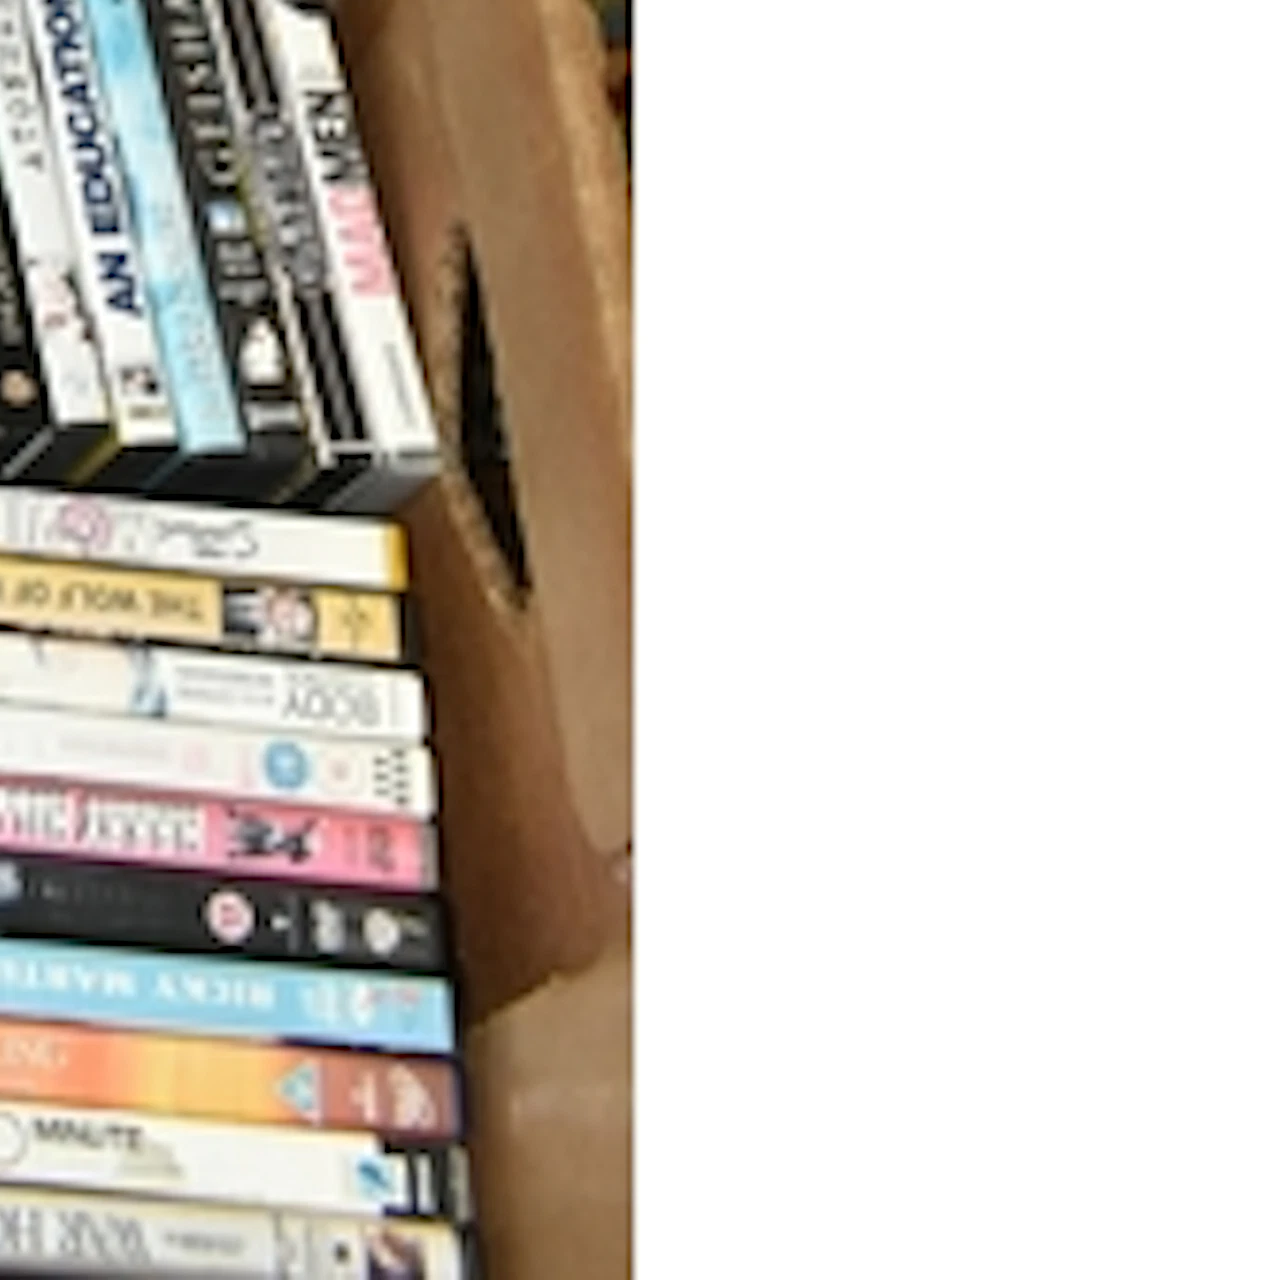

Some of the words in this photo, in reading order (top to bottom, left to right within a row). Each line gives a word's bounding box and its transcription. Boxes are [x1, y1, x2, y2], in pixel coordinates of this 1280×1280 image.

[304, 91, 366, 184] MEN
[331, 186, 392, 295] MAD
[101, 251, 141, 316] AN
[13, 582, 49, 608] OF
[61, 586, 139, 617] WOLF
[147, 593, 204, 623] THE
[281, 686, 384, 728] BODY
[156, 972, 275, 1010] RICKY
[34, 1116, 145, 1150] MINUTE
[55, 1210, 153, 1263] WAR
